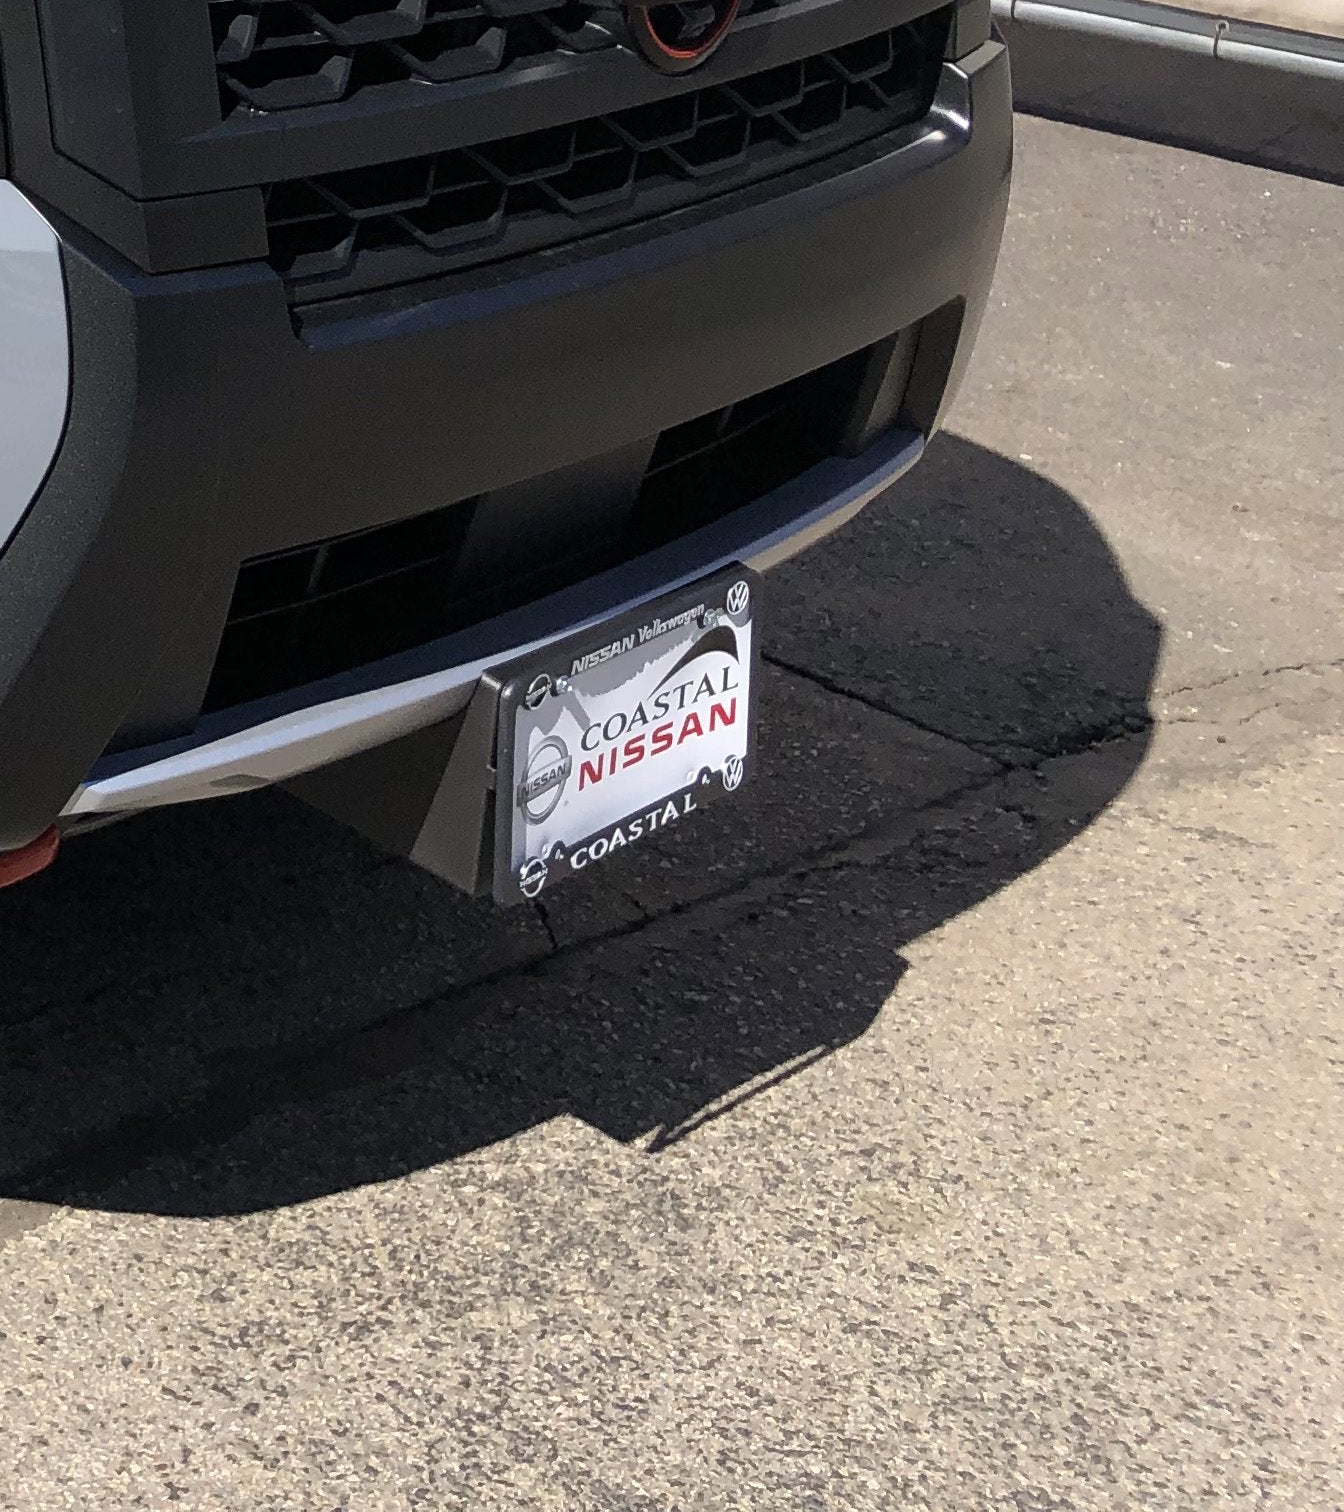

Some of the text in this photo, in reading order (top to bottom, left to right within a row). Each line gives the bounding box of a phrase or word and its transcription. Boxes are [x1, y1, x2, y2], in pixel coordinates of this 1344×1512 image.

[571, 634, 635, 676] NISSAN
[578, 697, 737, 791] NISSAN
[580, 666, 739, 752] COASTAL
[521, 763, 566, 798] NISSAN
[570, 793, 697, 869] COASTAL
